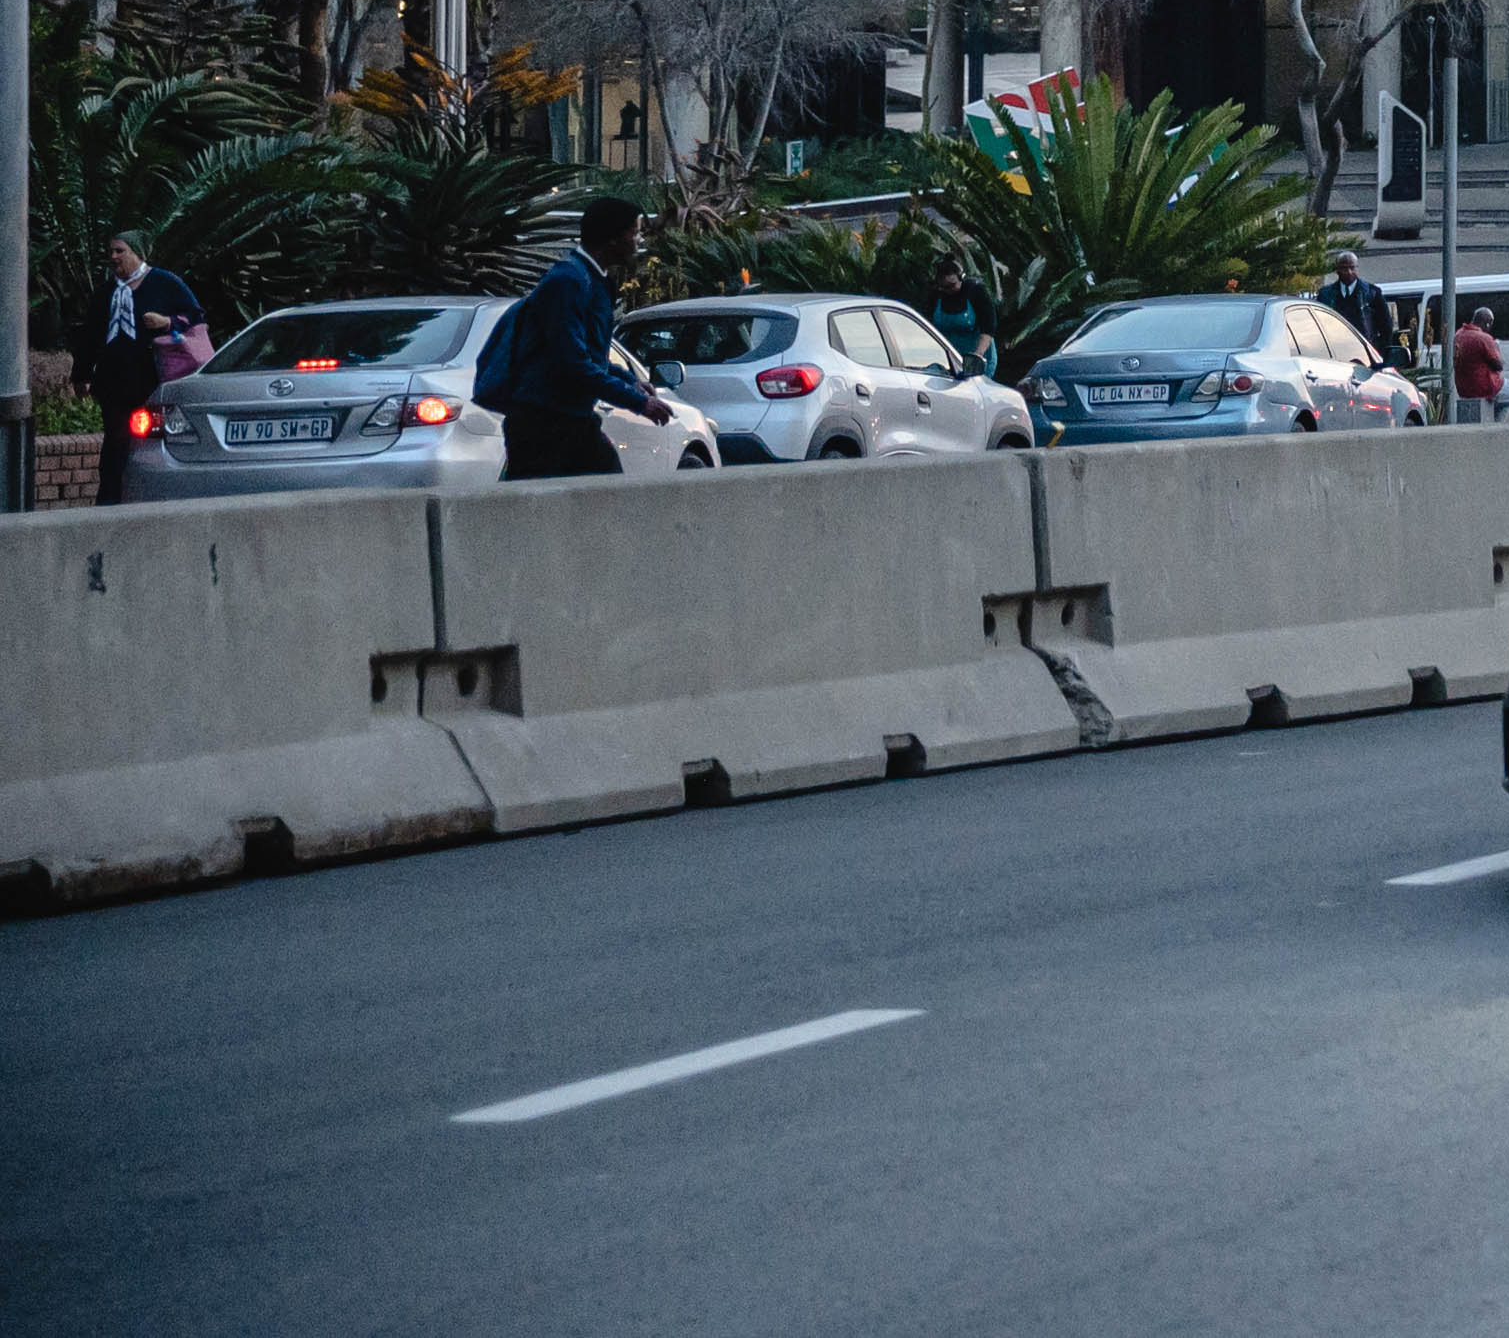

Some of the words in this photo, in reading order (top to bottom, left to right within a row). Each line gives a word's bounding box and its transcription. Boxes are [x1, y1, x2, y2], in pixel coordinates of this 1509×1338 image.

[1128, 386, 1143, 400] NX
[1152, 386, 1167, 399] GP
[230, 423, 248, 440] HV
[255, 422, 272, 439] 90
[280, 421, 297, 438] SW
[311, 420, 329, 437] GP
